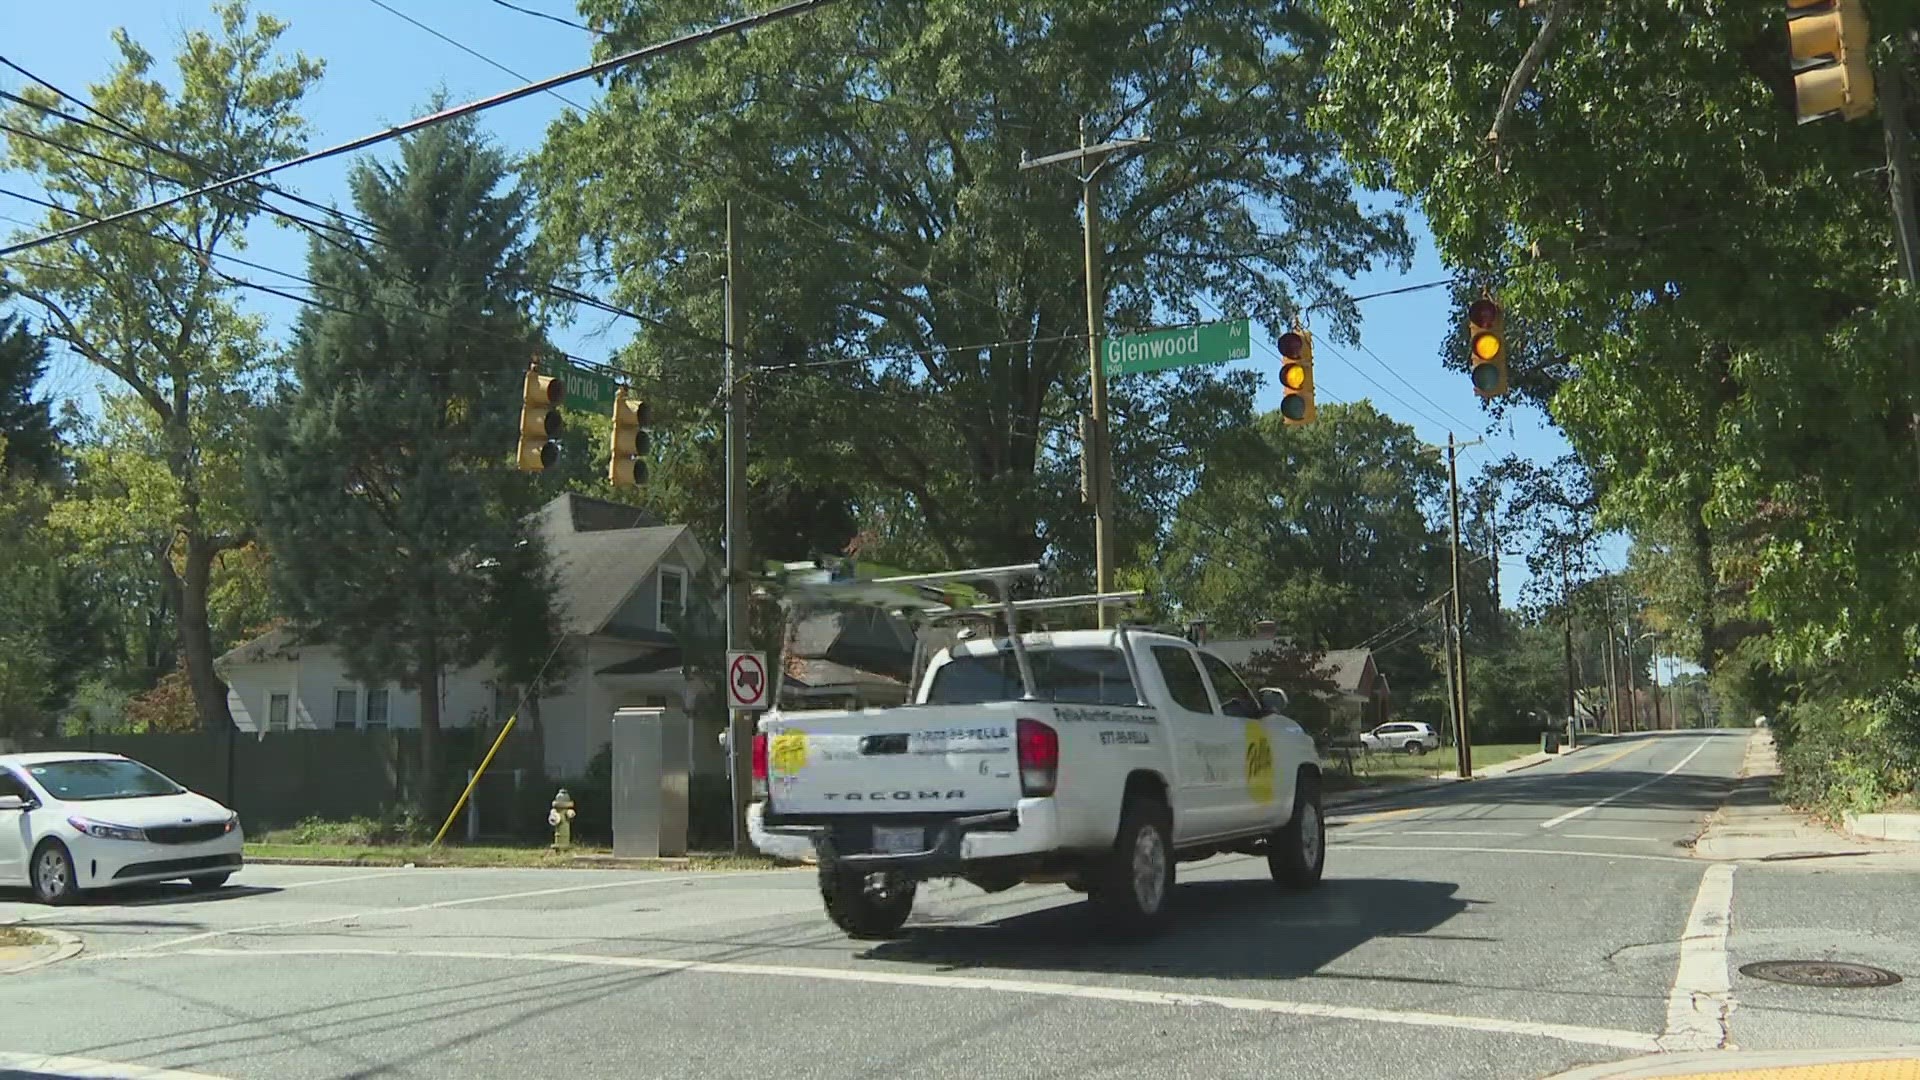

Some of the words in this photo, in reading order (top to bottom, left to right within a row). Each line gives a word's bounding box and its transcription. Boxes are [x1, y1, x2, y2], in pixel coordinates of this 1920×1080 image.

[1229, 325, 1242, 337] Av
[1109, 330, 1200, 363] Glenwood
[1228, 347, 1247, 360] 1400
[823, 789, 966, 800] TACOMA
